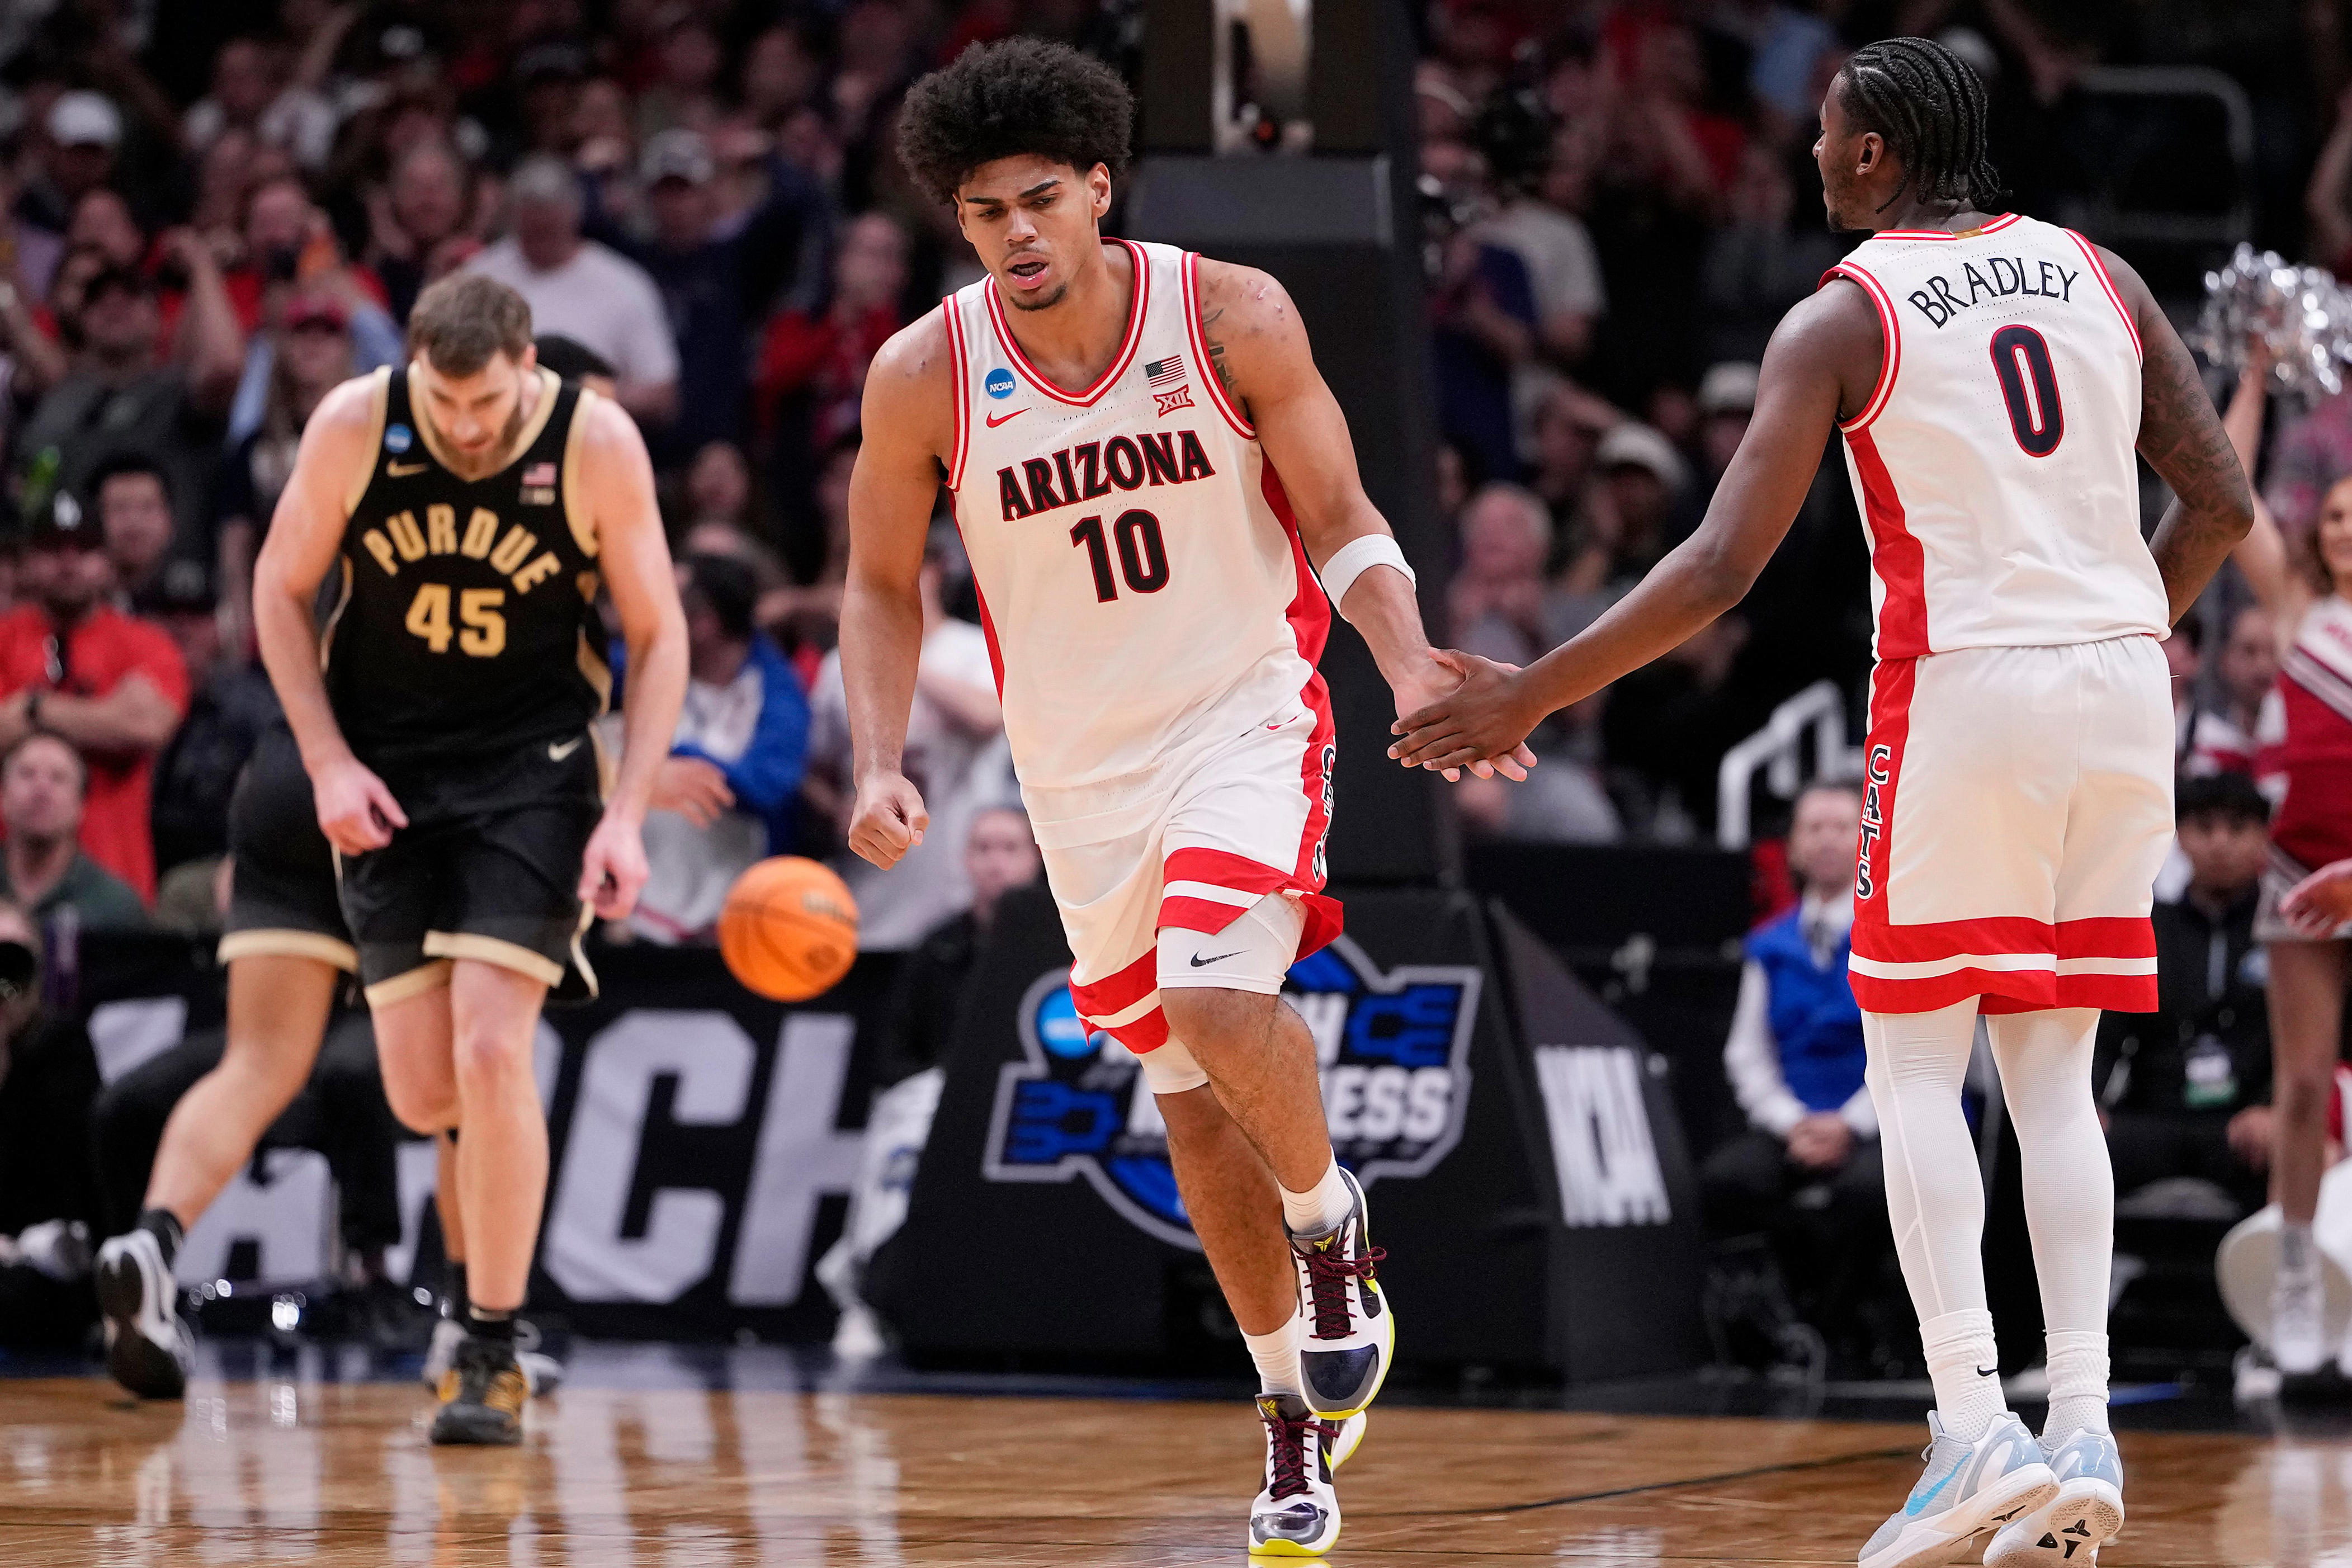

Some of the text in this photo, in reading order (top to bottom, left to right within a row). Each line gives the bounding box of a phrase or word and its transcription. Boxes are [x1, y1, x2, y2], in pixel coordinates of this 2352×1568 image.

[1907, 257, 2079, 329] BRADLEY
[989, 381, 1014, 393] NCAA
[1155, 386, 1193, 415] XII
[1990, 324, 2064, 457] 0
[997, 430, 1216, 521] ARIZONA
[362, 503, 561, 595] PURDUE
[1070, 509, 1169, 603] 10
[405, 583, 507, 658] 45
[1856, 744, 1891, 900] CATS
